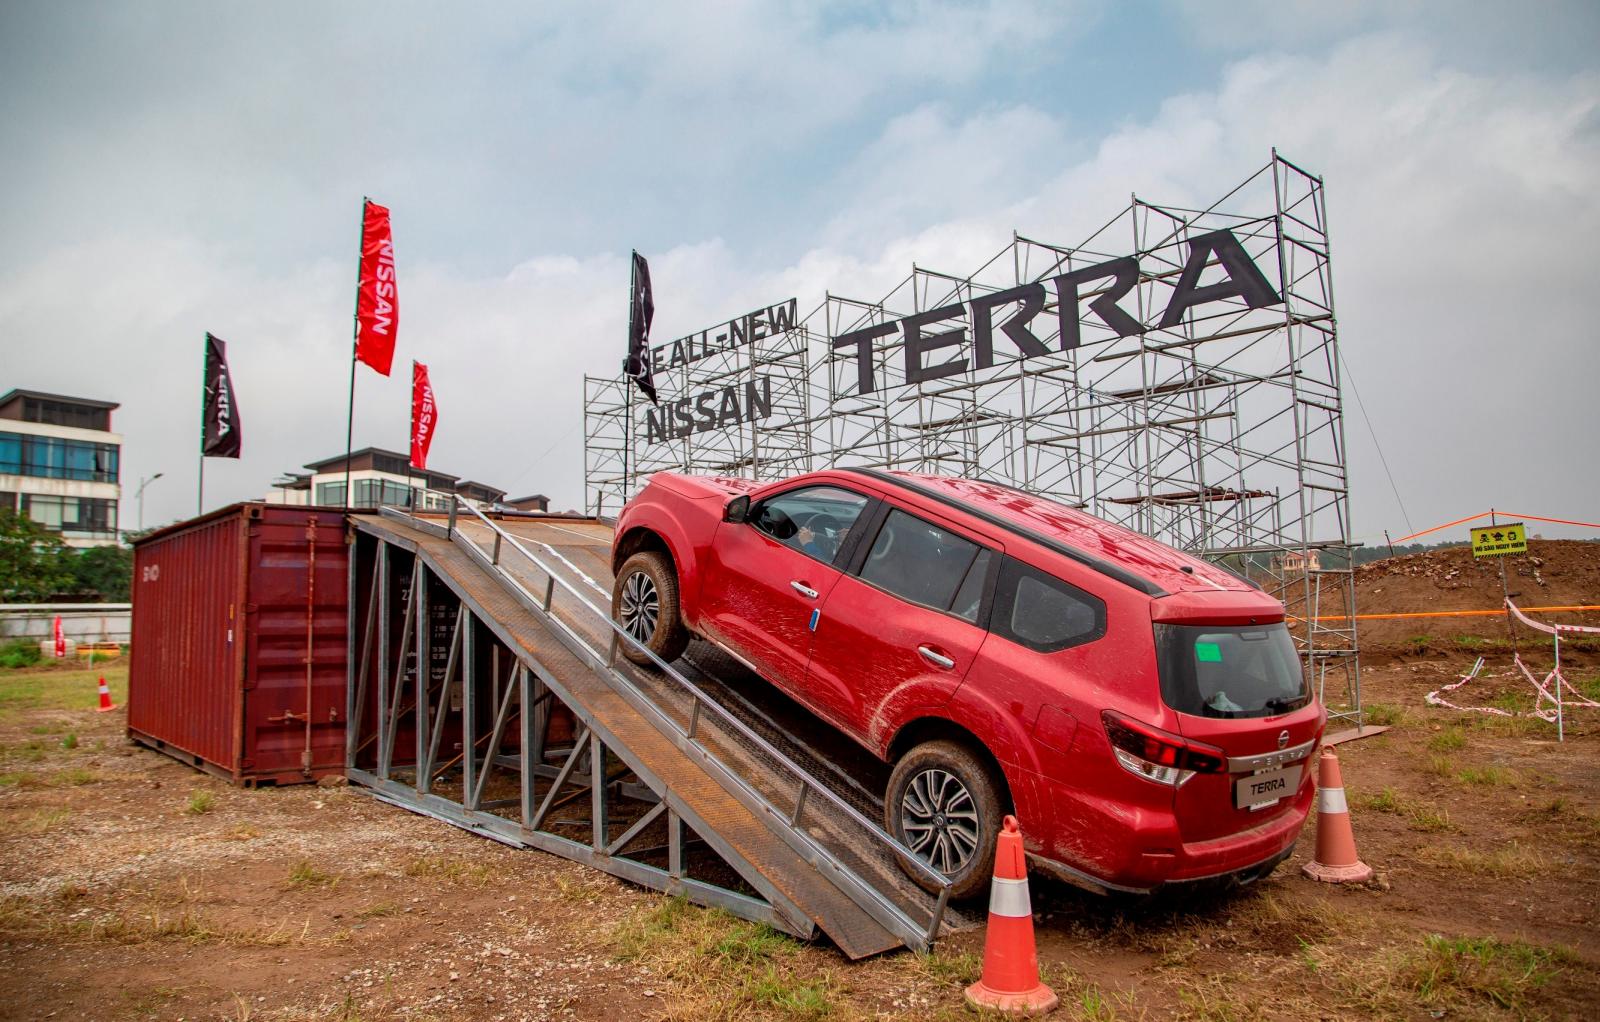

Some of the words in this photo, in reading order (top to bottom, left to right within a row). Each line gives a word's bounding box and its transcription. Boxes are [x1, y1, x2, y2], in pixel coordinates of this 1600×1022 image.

[372, 238, 394, 336] NISSAN
[832, 228, 1286, 396] TERRA
[671, 298, 798, 368] ALL-NEW
[647, 376, 772, 446] NISSAN
[1250, 778, 1285, 796] TERRA
